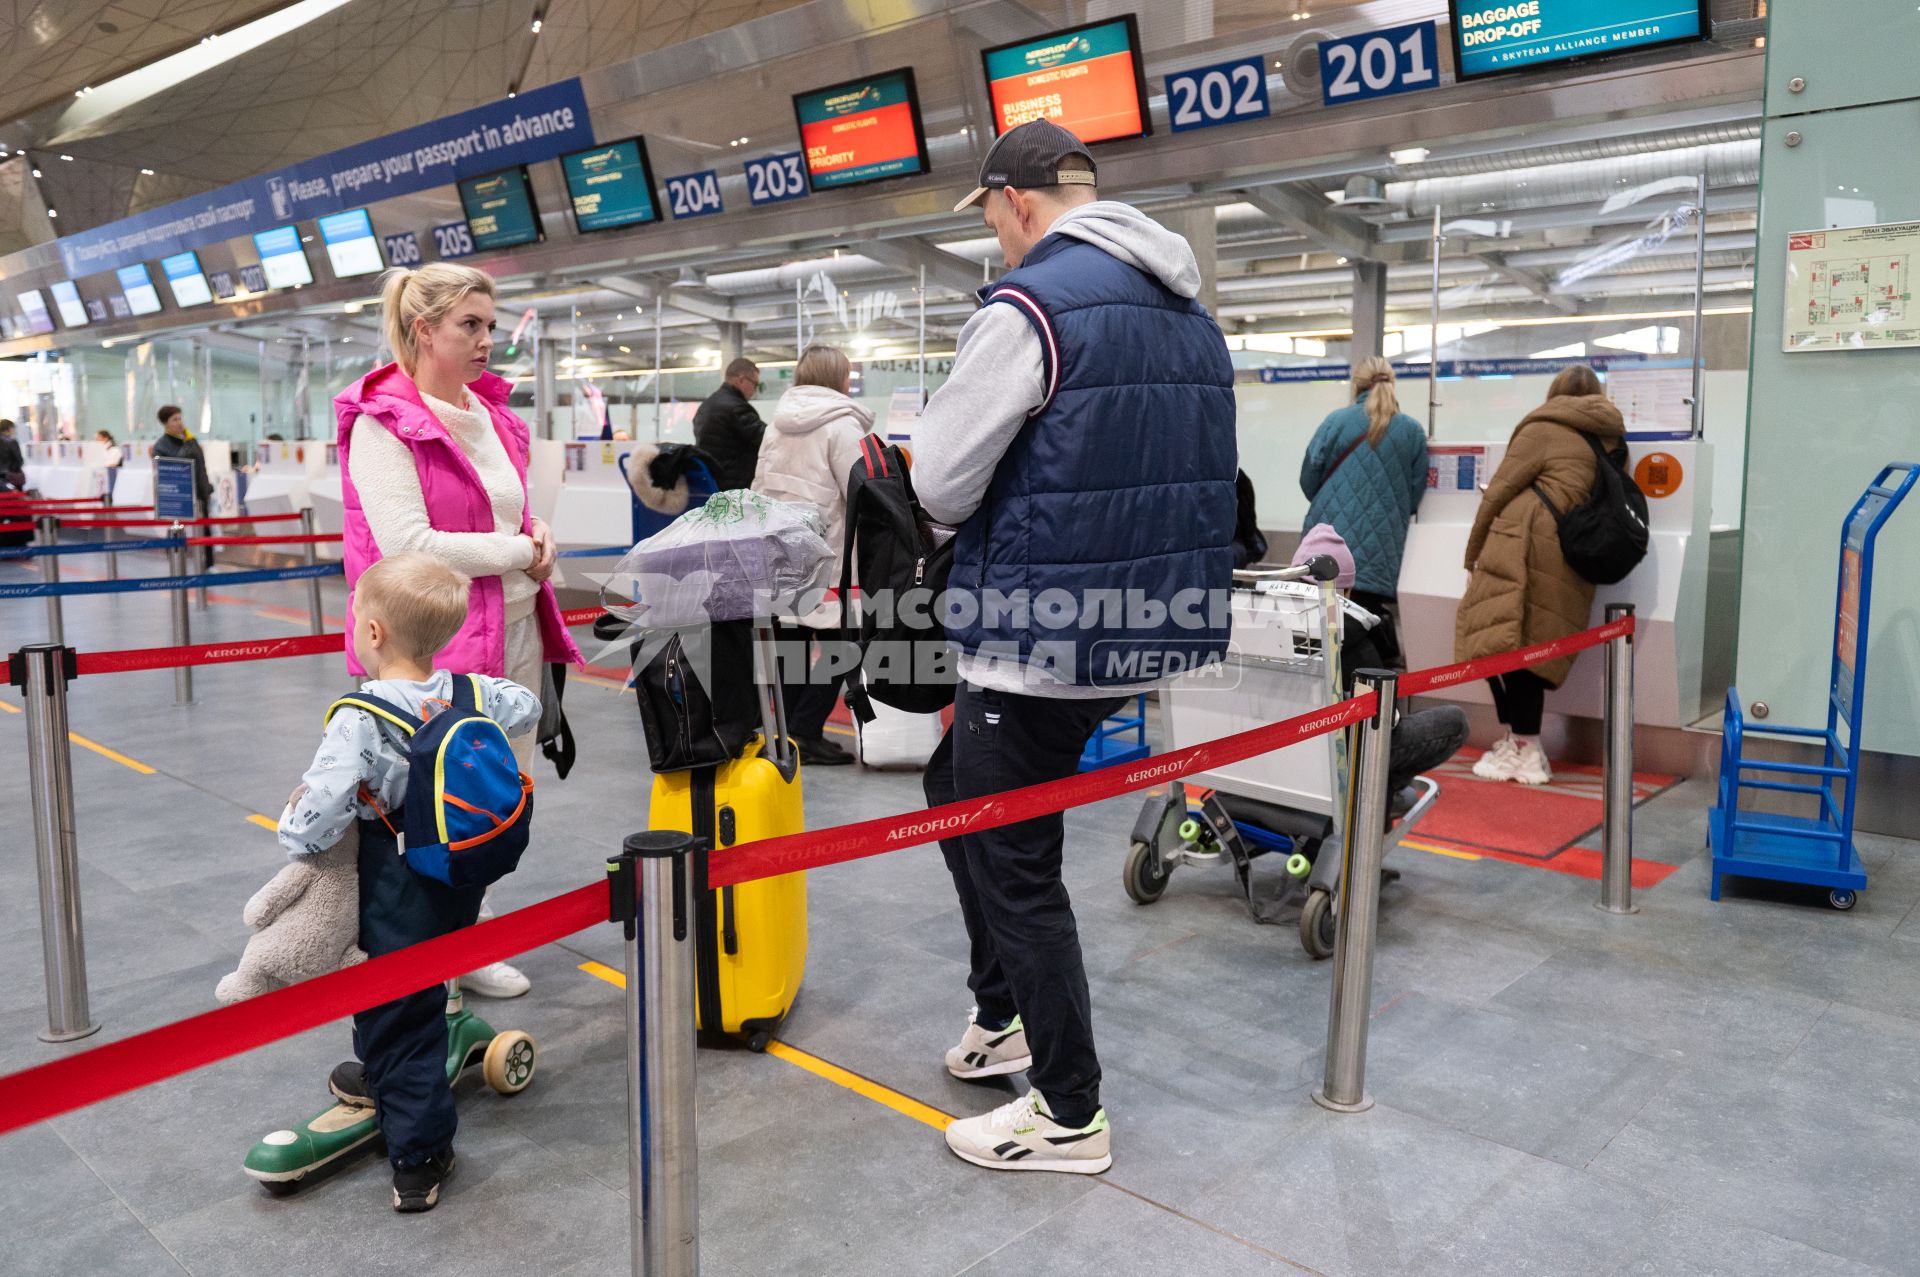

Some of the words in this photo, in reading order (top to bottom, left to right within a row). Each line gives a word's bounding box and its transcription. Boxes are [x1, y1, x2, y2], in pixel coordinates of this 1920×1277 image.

[1462, 1, 1540, 29] BAGGAGE
[1464, 19, 1542, 47] DROP-OFF
[1502, 45, 1550, 61] SKYTEAM
[1554, 35, 1607, 52] ALLIANCE
[1612, 25, 1660, 42] MEMBER
[1327, 28, 1433, 98] 201
[1003, 93, 1062, 115] BUSINESS
[1171, 64, 1263, 125] 202
[1005, 105, 1063, 126] CHECK-IN
[288, 176, 331, 202] Please,
[331, 162, 382, 196] prepare
[380, 153, 414, 184] your
[414, 128, 484, 175] passport
[484, 124, 502, 150] in
[502, 106, 575, 145] advance
[807, 145, 827, 158] SKY
[809, 151, 855, 169] PRIORITY
[749, 156, 804, 200] 203
[669, 174, 720, 214] 204
[387, 236, 420, 265] 206
[434, 224, 473, 257] 205
[204, 646, 269, 659] AEROFLOT
[1430, 671, 1462, 685] AEROFLOT
[1298, 713, 1344, 734] AEROFLOT
[1125, 760, 1185, 785] AEROFLOT
[887, 813, 970, 842] AEROFLOT
